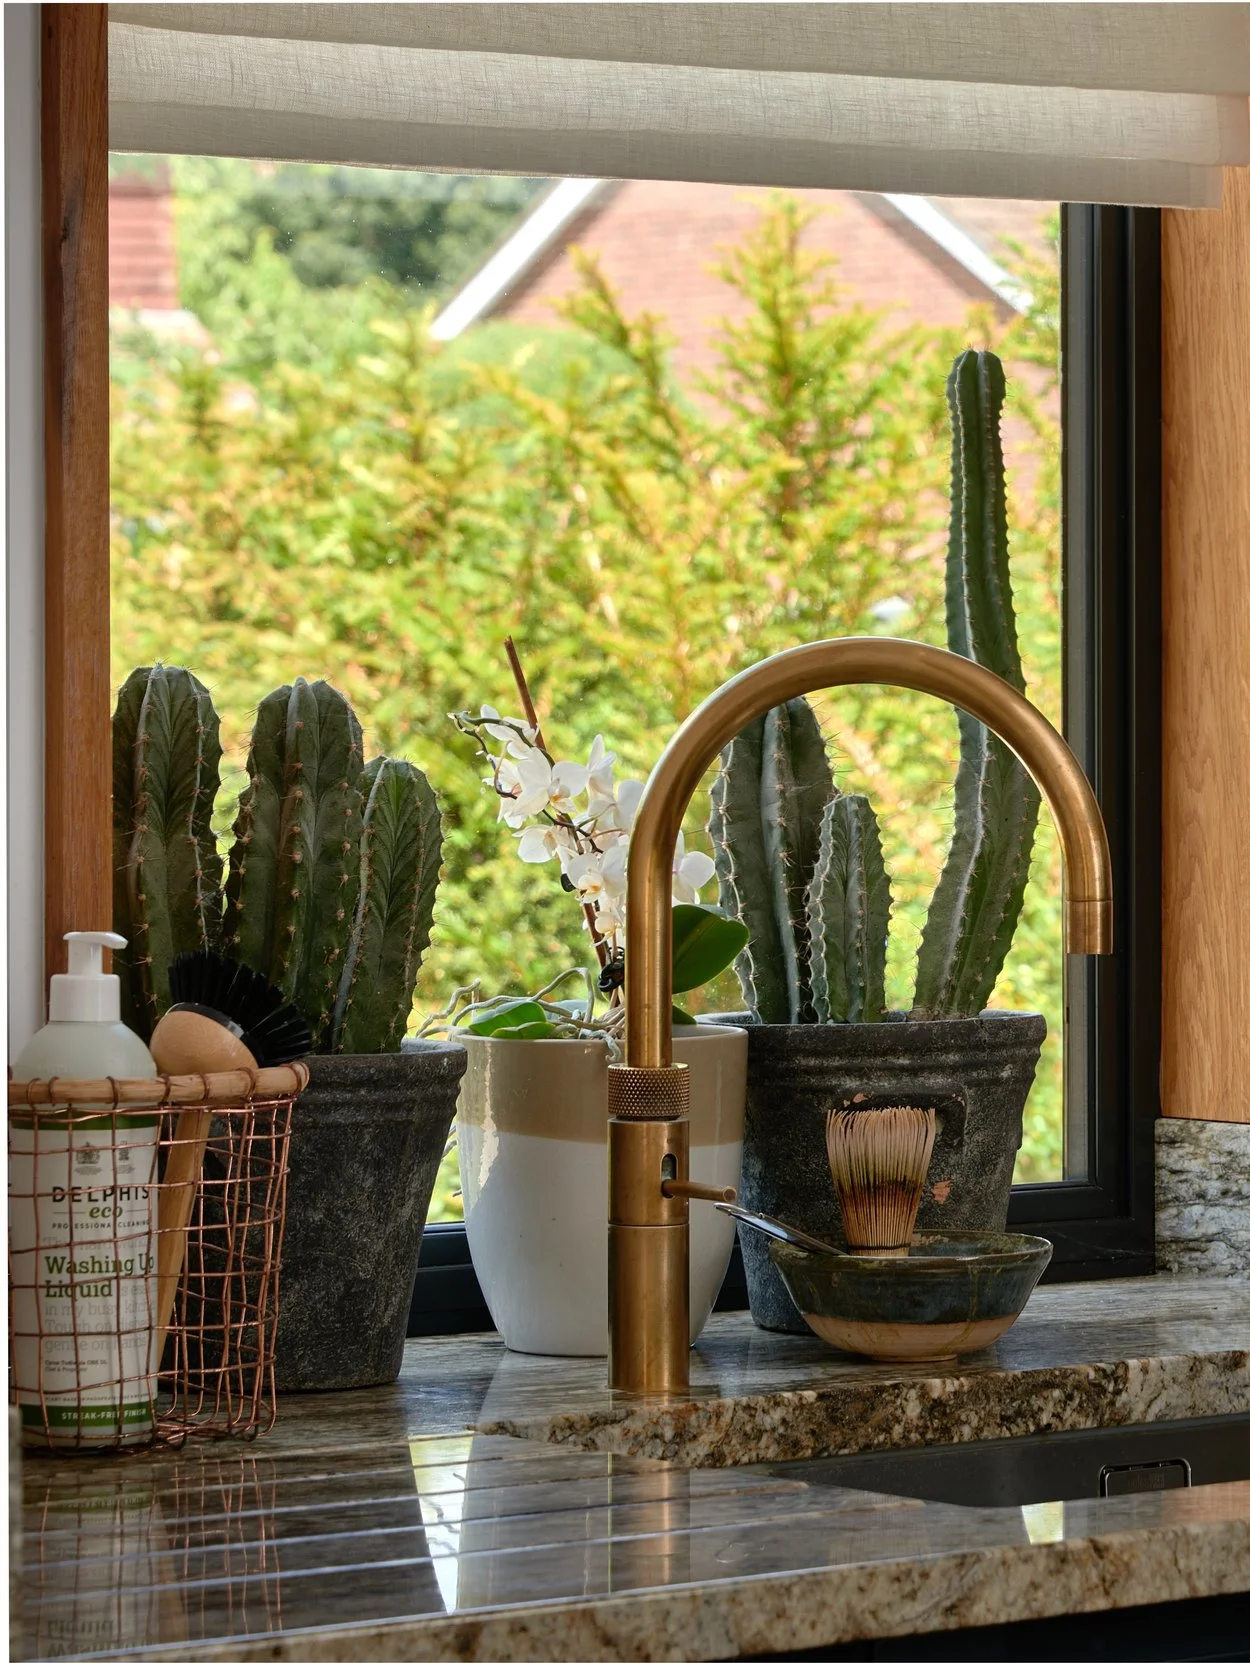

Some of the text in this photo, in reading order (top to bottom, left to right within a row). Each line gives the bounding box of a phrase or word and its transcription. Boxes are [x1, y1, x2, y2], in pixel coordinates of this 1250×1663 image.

[52, 1185, 150, 1203] DELPHIS
[88, 1206, 123, 1219] eco
[52, 1222, 115, 1230] PROESSIONA
[44, 1253, 154, 1276] Washing Up
[44, 1280, 113, 1302] Liquid
[88, 1302, 117, 1316] bus
[45, 1319, 91, 1333] Touh
[62, 1408, 147, 1420] STRAK-FRE FINISH
